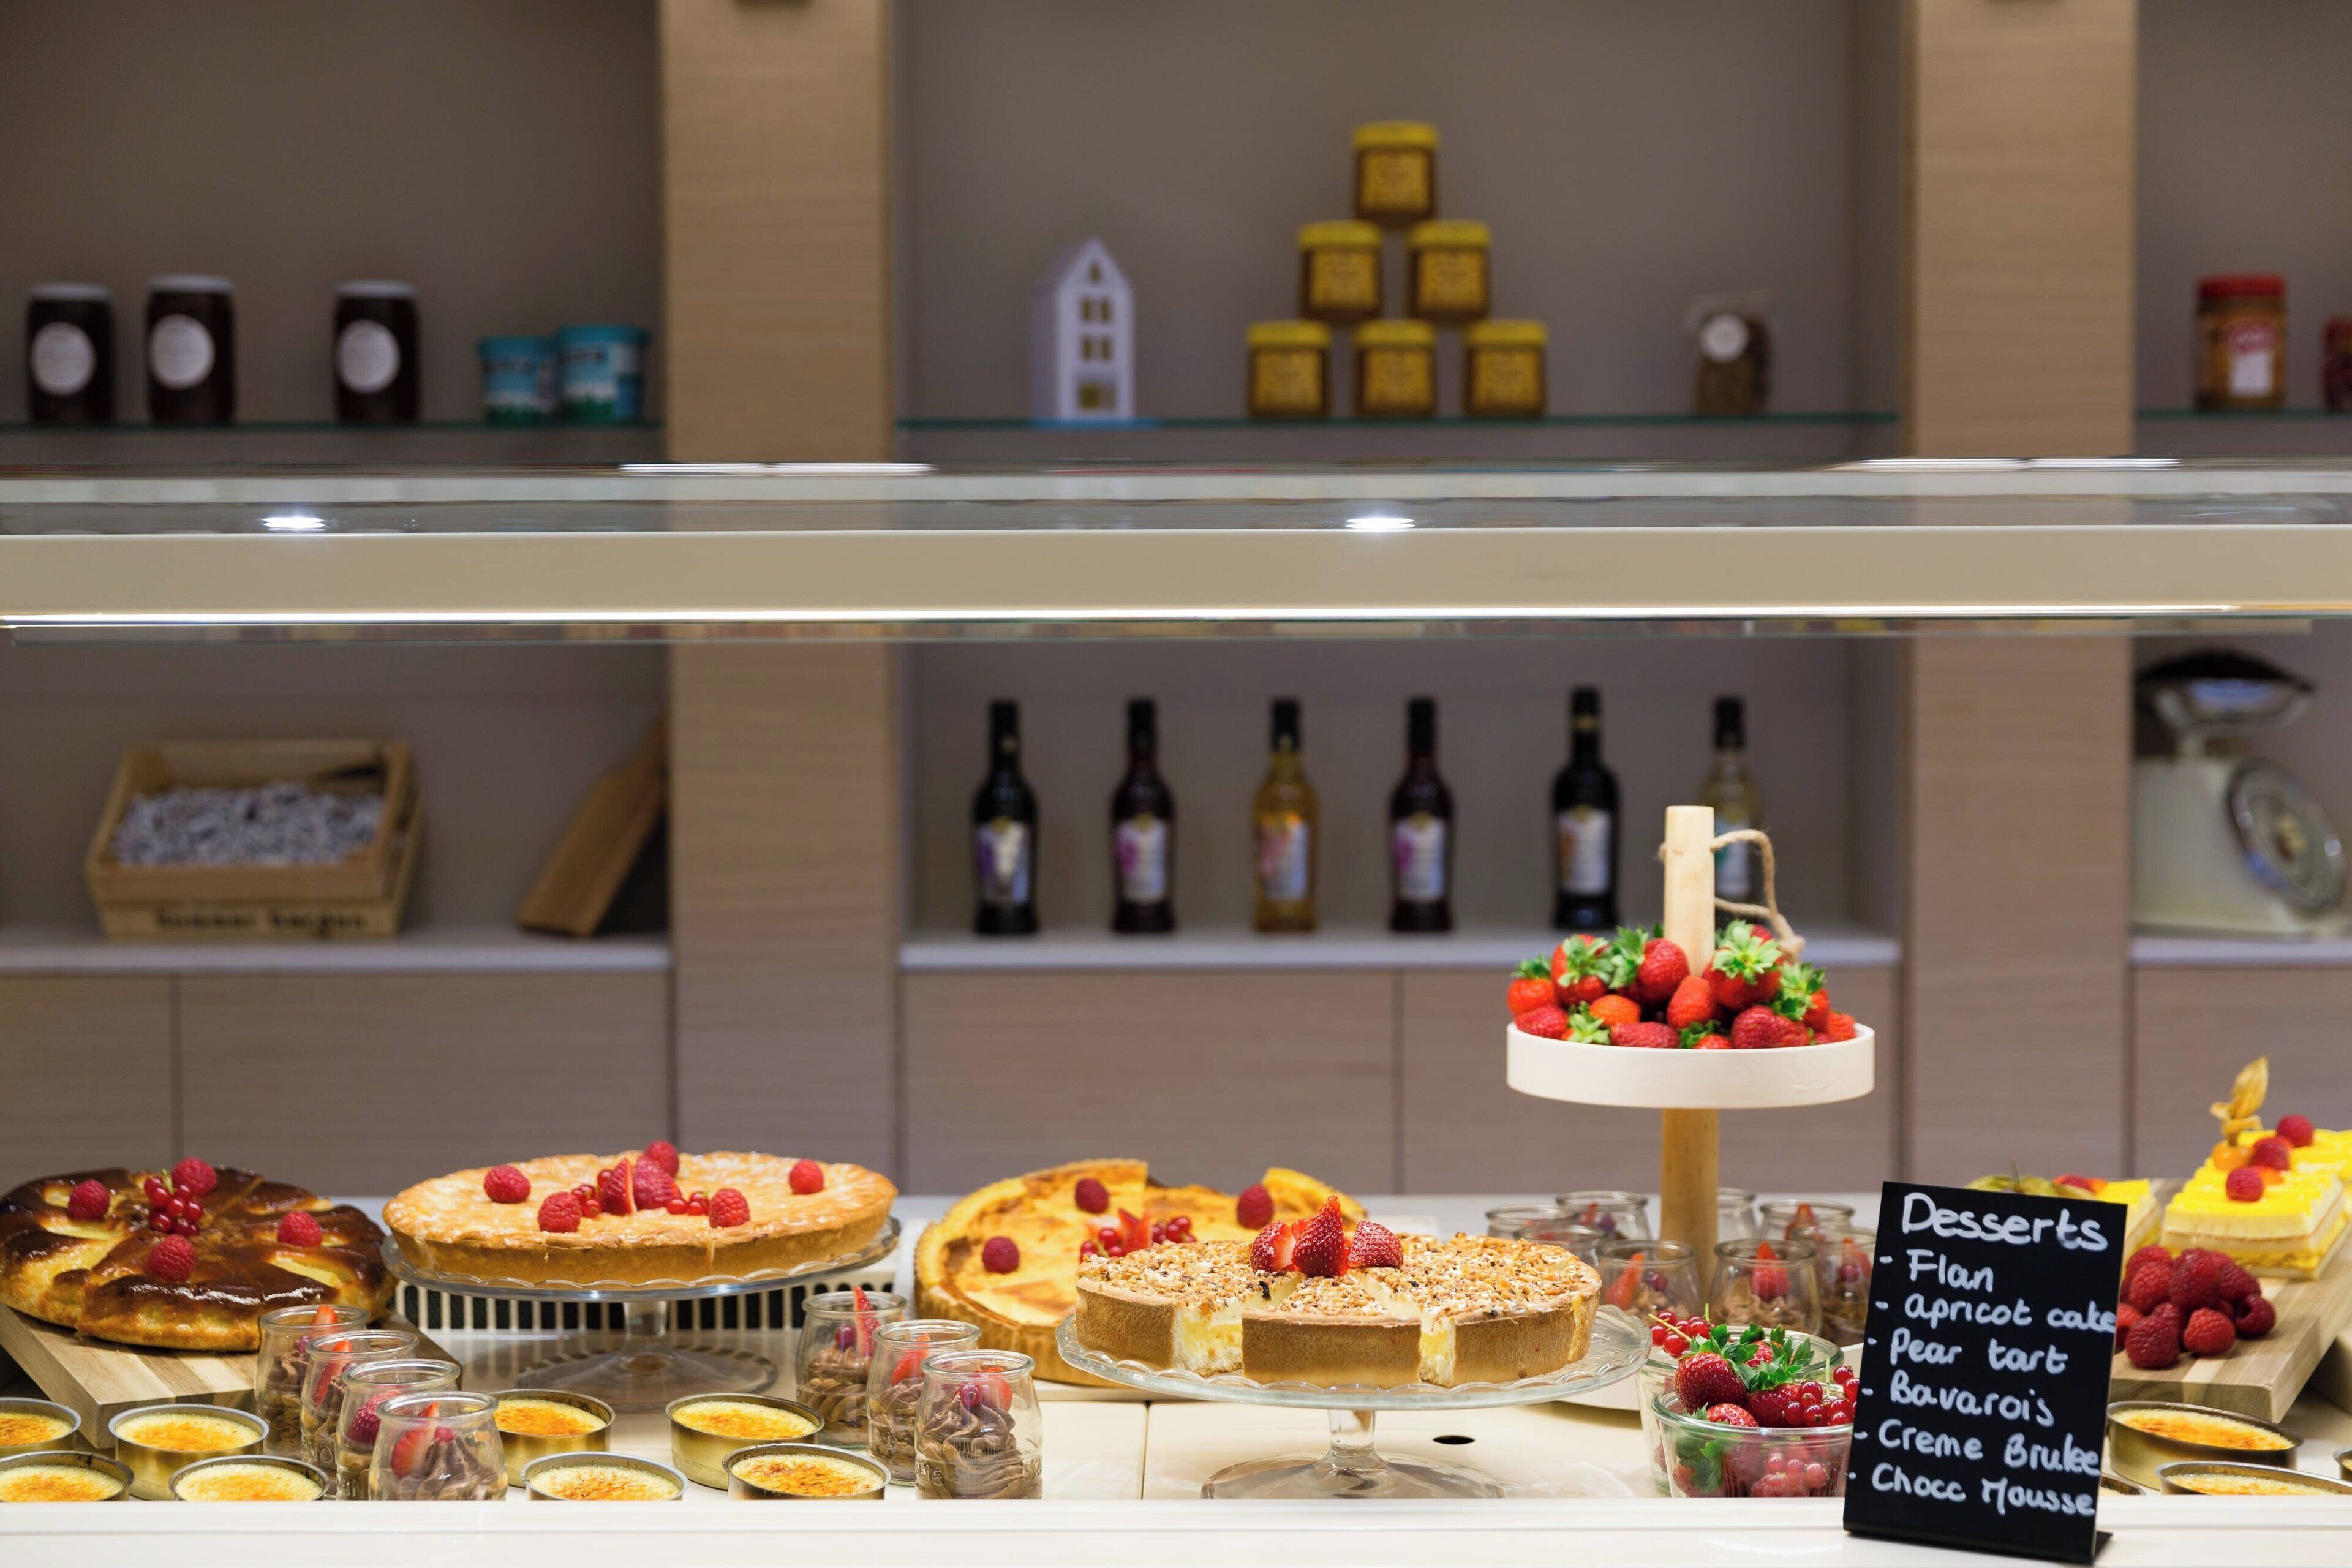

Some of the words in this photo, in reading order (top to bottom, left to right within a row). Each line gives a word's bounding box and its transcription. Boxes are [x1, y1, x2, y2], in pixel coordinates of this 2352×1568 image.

[1902, 1192, 2108, 1251] Desserts
[1906, 1249, 1994, 1293] Flan
[2046, 1300, 2116, 1334] cake
[1890, 1327, 1963, 1366] Pear
[1988, 1338, 2069, 1374] tart
[1890, 1369, 2055, 1427] Bavarois
[1878, 1419, 1984, 1460] Creme
[1981, 1477, 2097, 1516] Mousse
